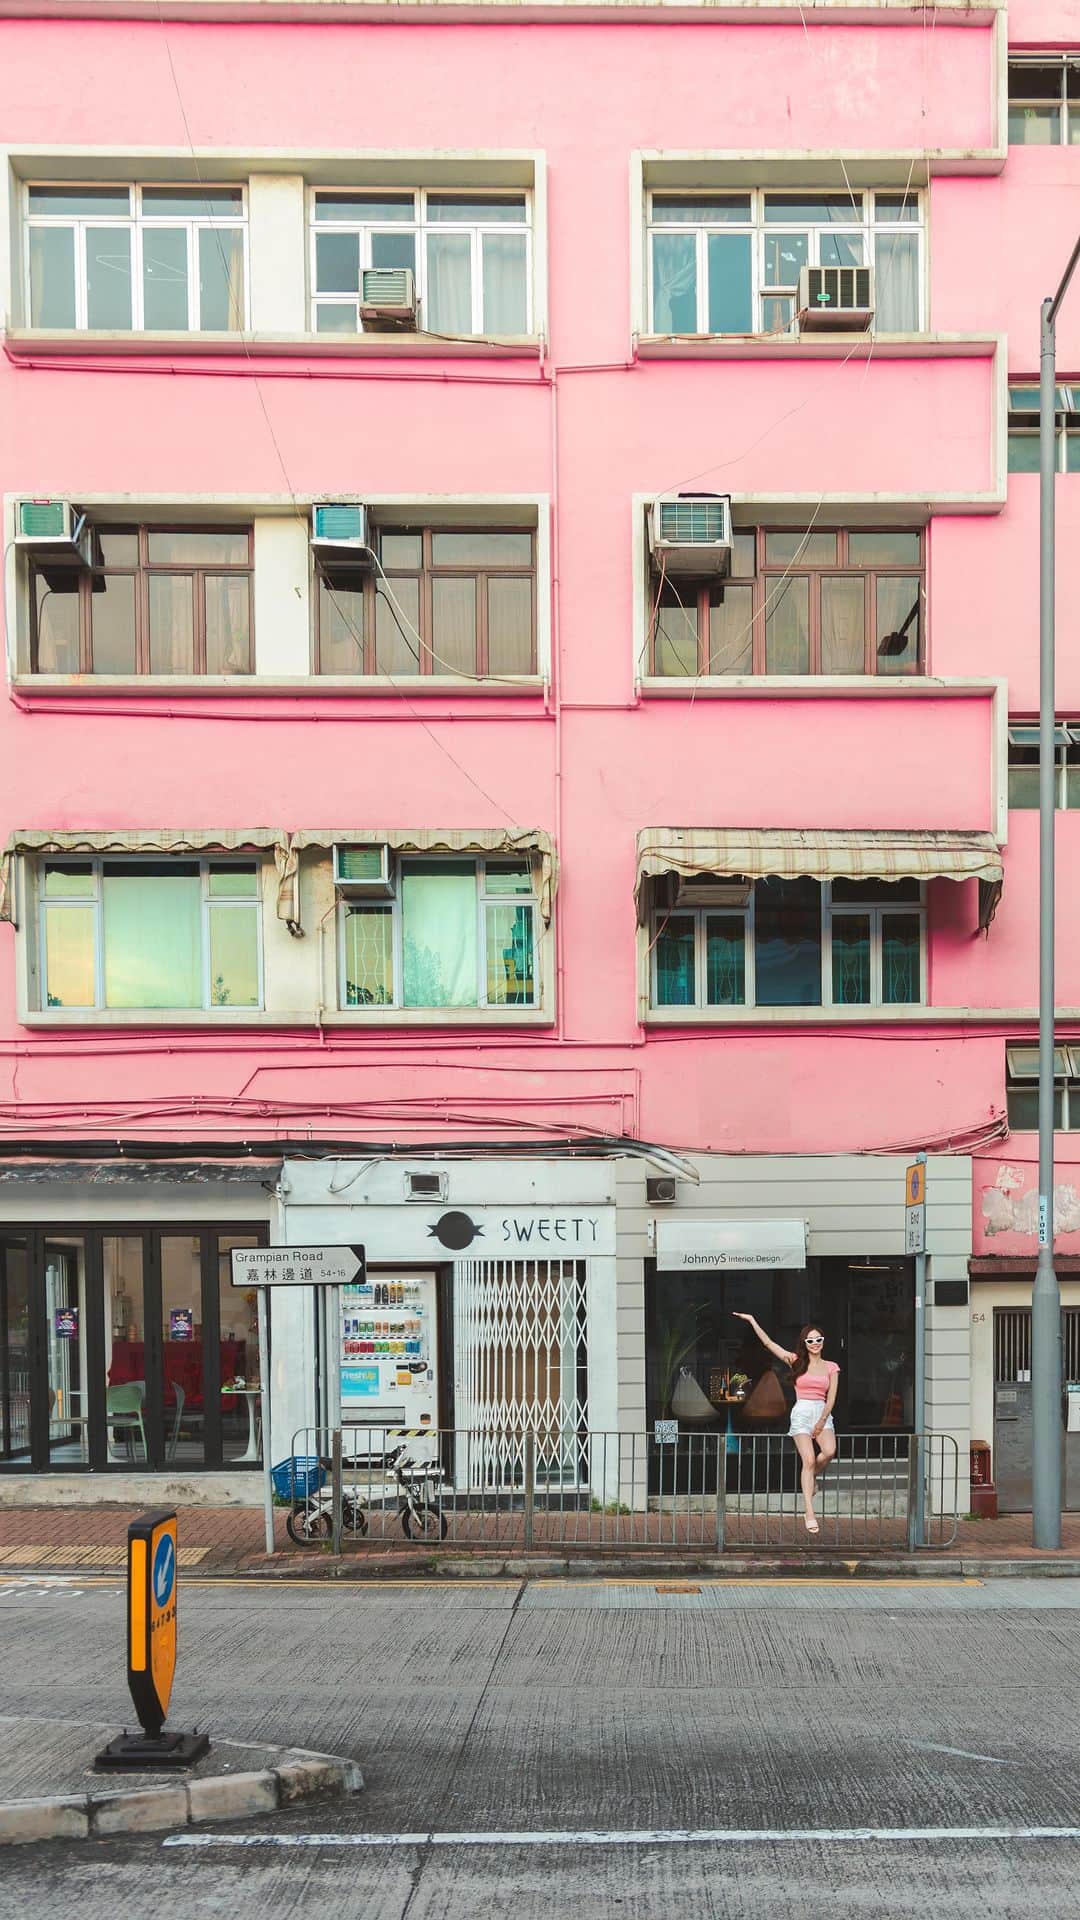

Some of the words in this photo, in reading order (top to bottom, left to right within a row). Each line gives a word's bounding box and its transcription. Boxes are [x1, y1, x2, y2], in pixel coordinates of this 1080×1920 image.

[502, 1219, 599, 1241] SWEETY
[235, 1252, 289, 1263] Grampian
[293, 1251, 323, 1261] Road
[682, 1253, 727, 1265] JohnnyS
[728, 1255, 754, 1263] Interior
[756, 1255, 781, 1263] Design
[246, 1267, 313, 1281] 嘉林邊道
[972, 1313, 986, 1323] 54
